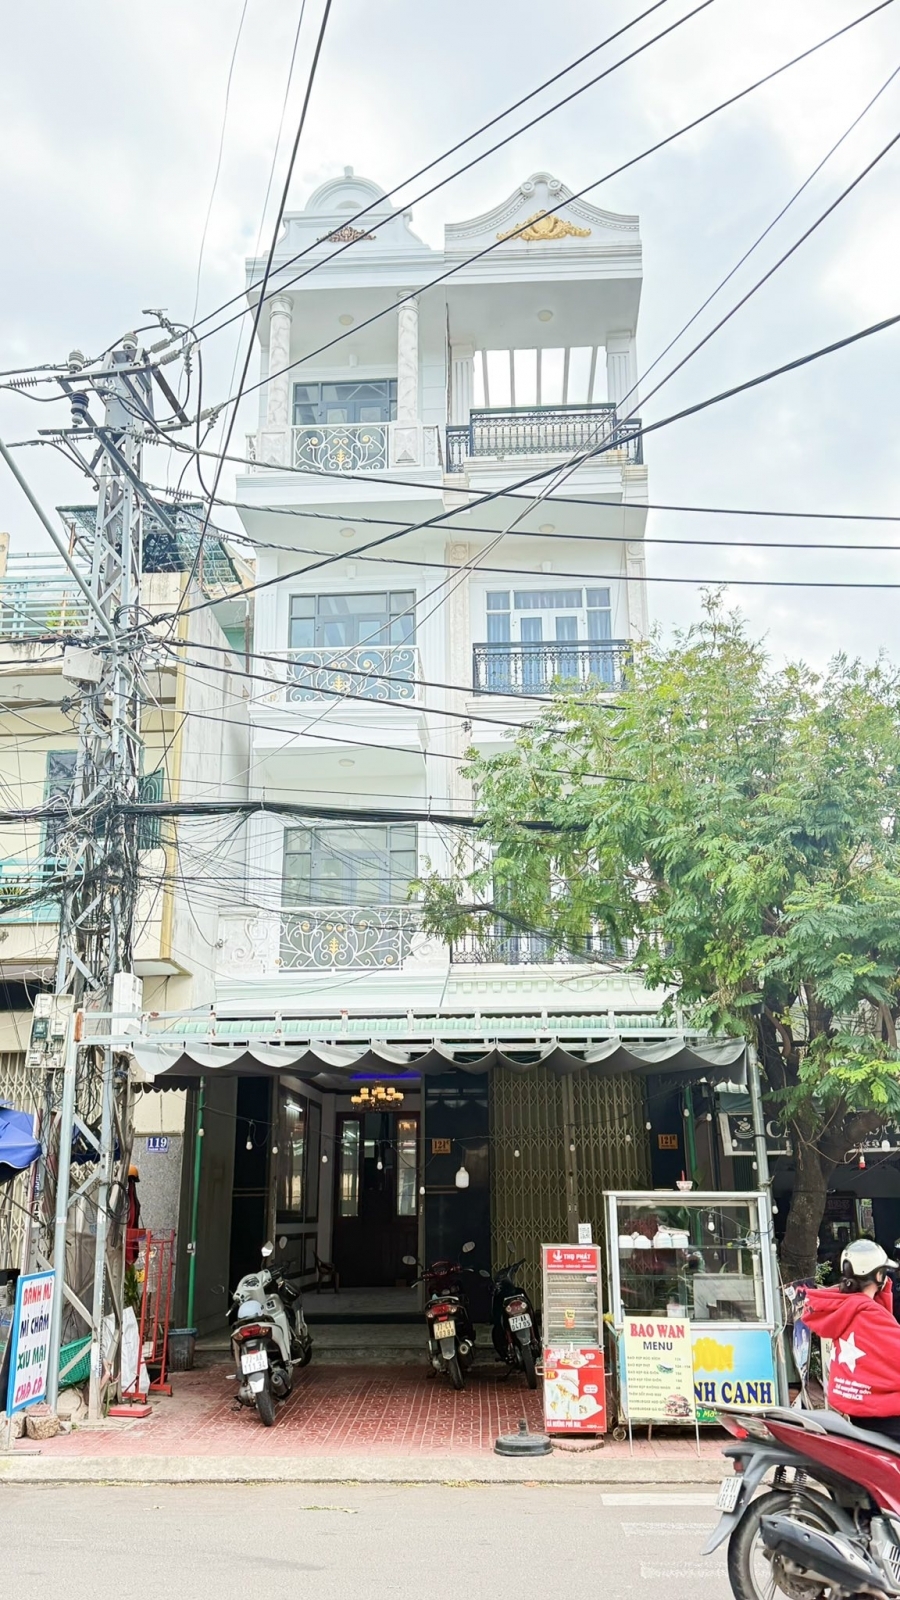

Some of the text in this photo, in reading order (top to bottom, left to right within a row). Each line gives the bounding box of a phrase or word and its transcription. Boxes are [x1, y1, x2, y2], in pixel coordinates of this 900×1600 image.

[149, 1137, 167, 1148] 119
[563, 1252, 591, 1261] THỌ PHÁT
[23, 1281, 42, 1305] BÁNH
[630, 1323, 685, 1339] BAO WAN
[643, 1341, 673, 1351] MENU
[17, 1345, 31, 1371] XÍU
[694, 1382, 772, 1404] NH CANH
